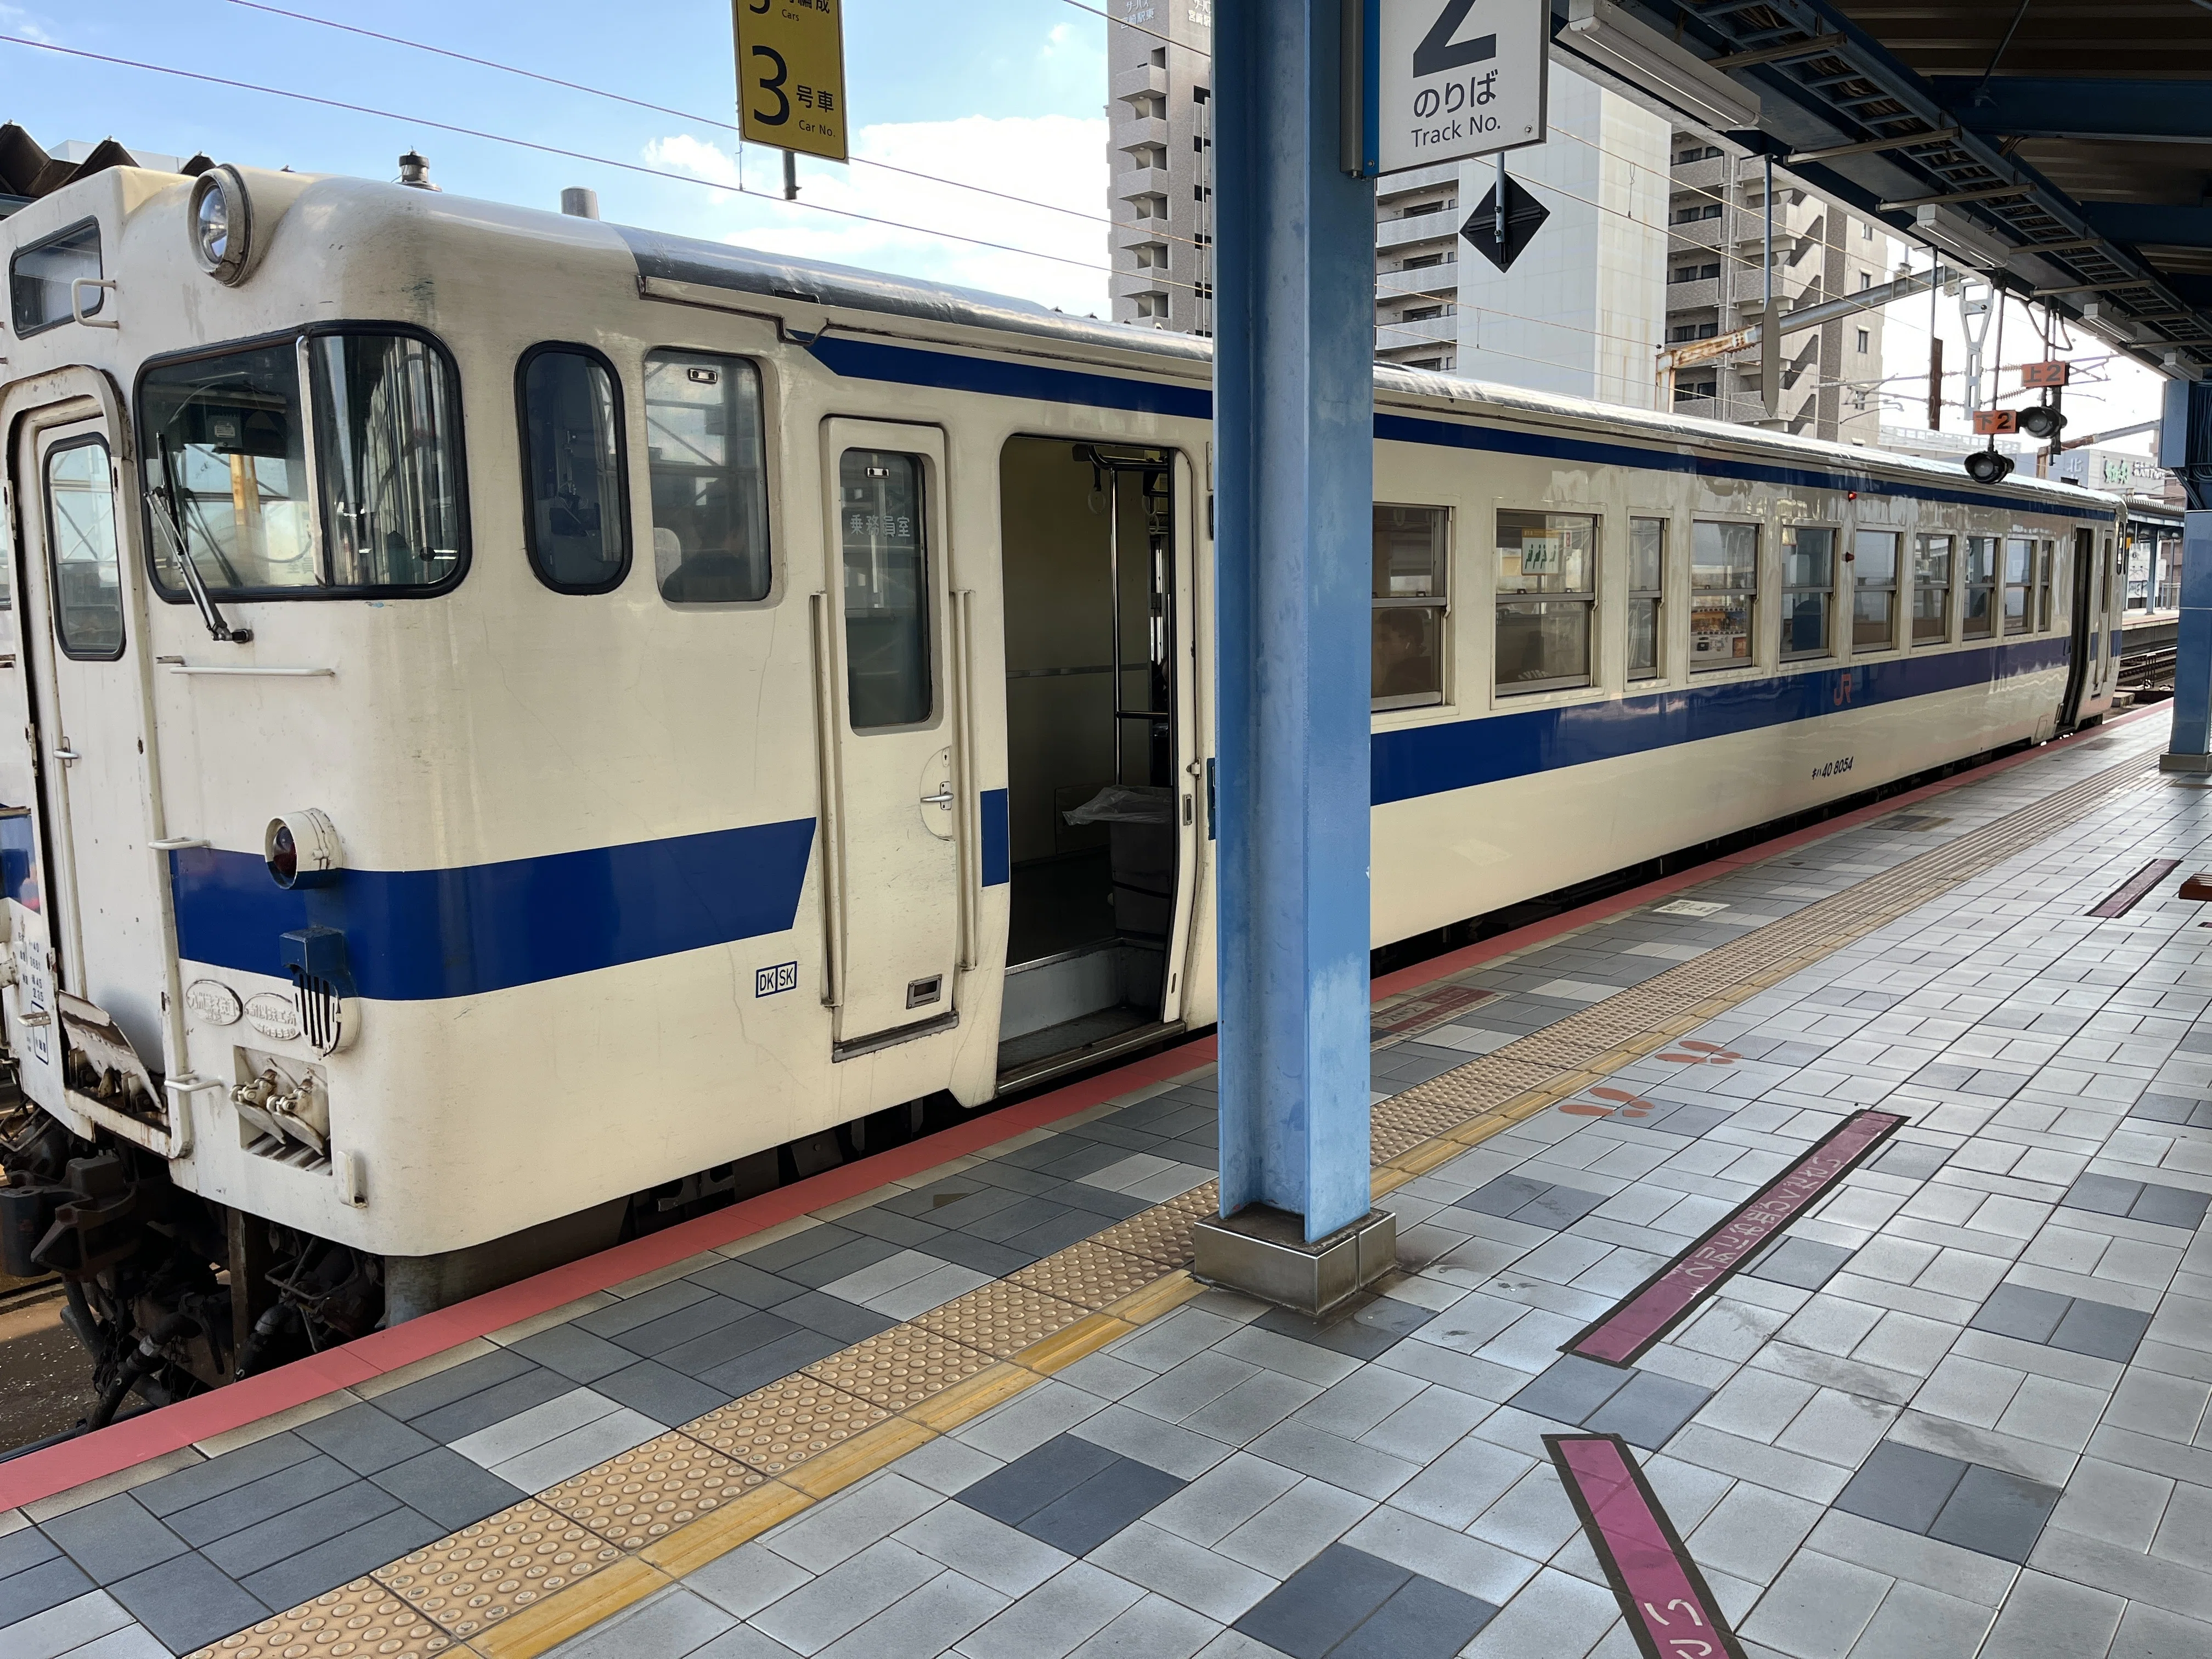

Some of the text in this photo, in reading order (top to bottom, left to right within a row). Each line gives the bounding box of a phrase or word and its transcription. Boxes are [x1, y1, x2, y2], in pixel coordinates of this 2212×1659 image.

[782, 9, 799, 21] Cars
[1413, 0, 1497, 78] 2
[752, 46, 834, 126] 3 号車
[1414, 69, 1498, 118] のりば
[799, 120, 836, 137] Car No.
[1411, 115, 1500, 147] Track No.
[2024, 364, 2061, 383] 上2
[1976, 413, 2012, 431] 下2
[850, 514, 911, 537] 乗務員室
[1833, 674, 1852, 706] JR
[1833, 756, 1853, 775] 8054
[760, 967, 793, 991] DK SK
[1685, 1156, 1841, 1278] 2列にお並びください
